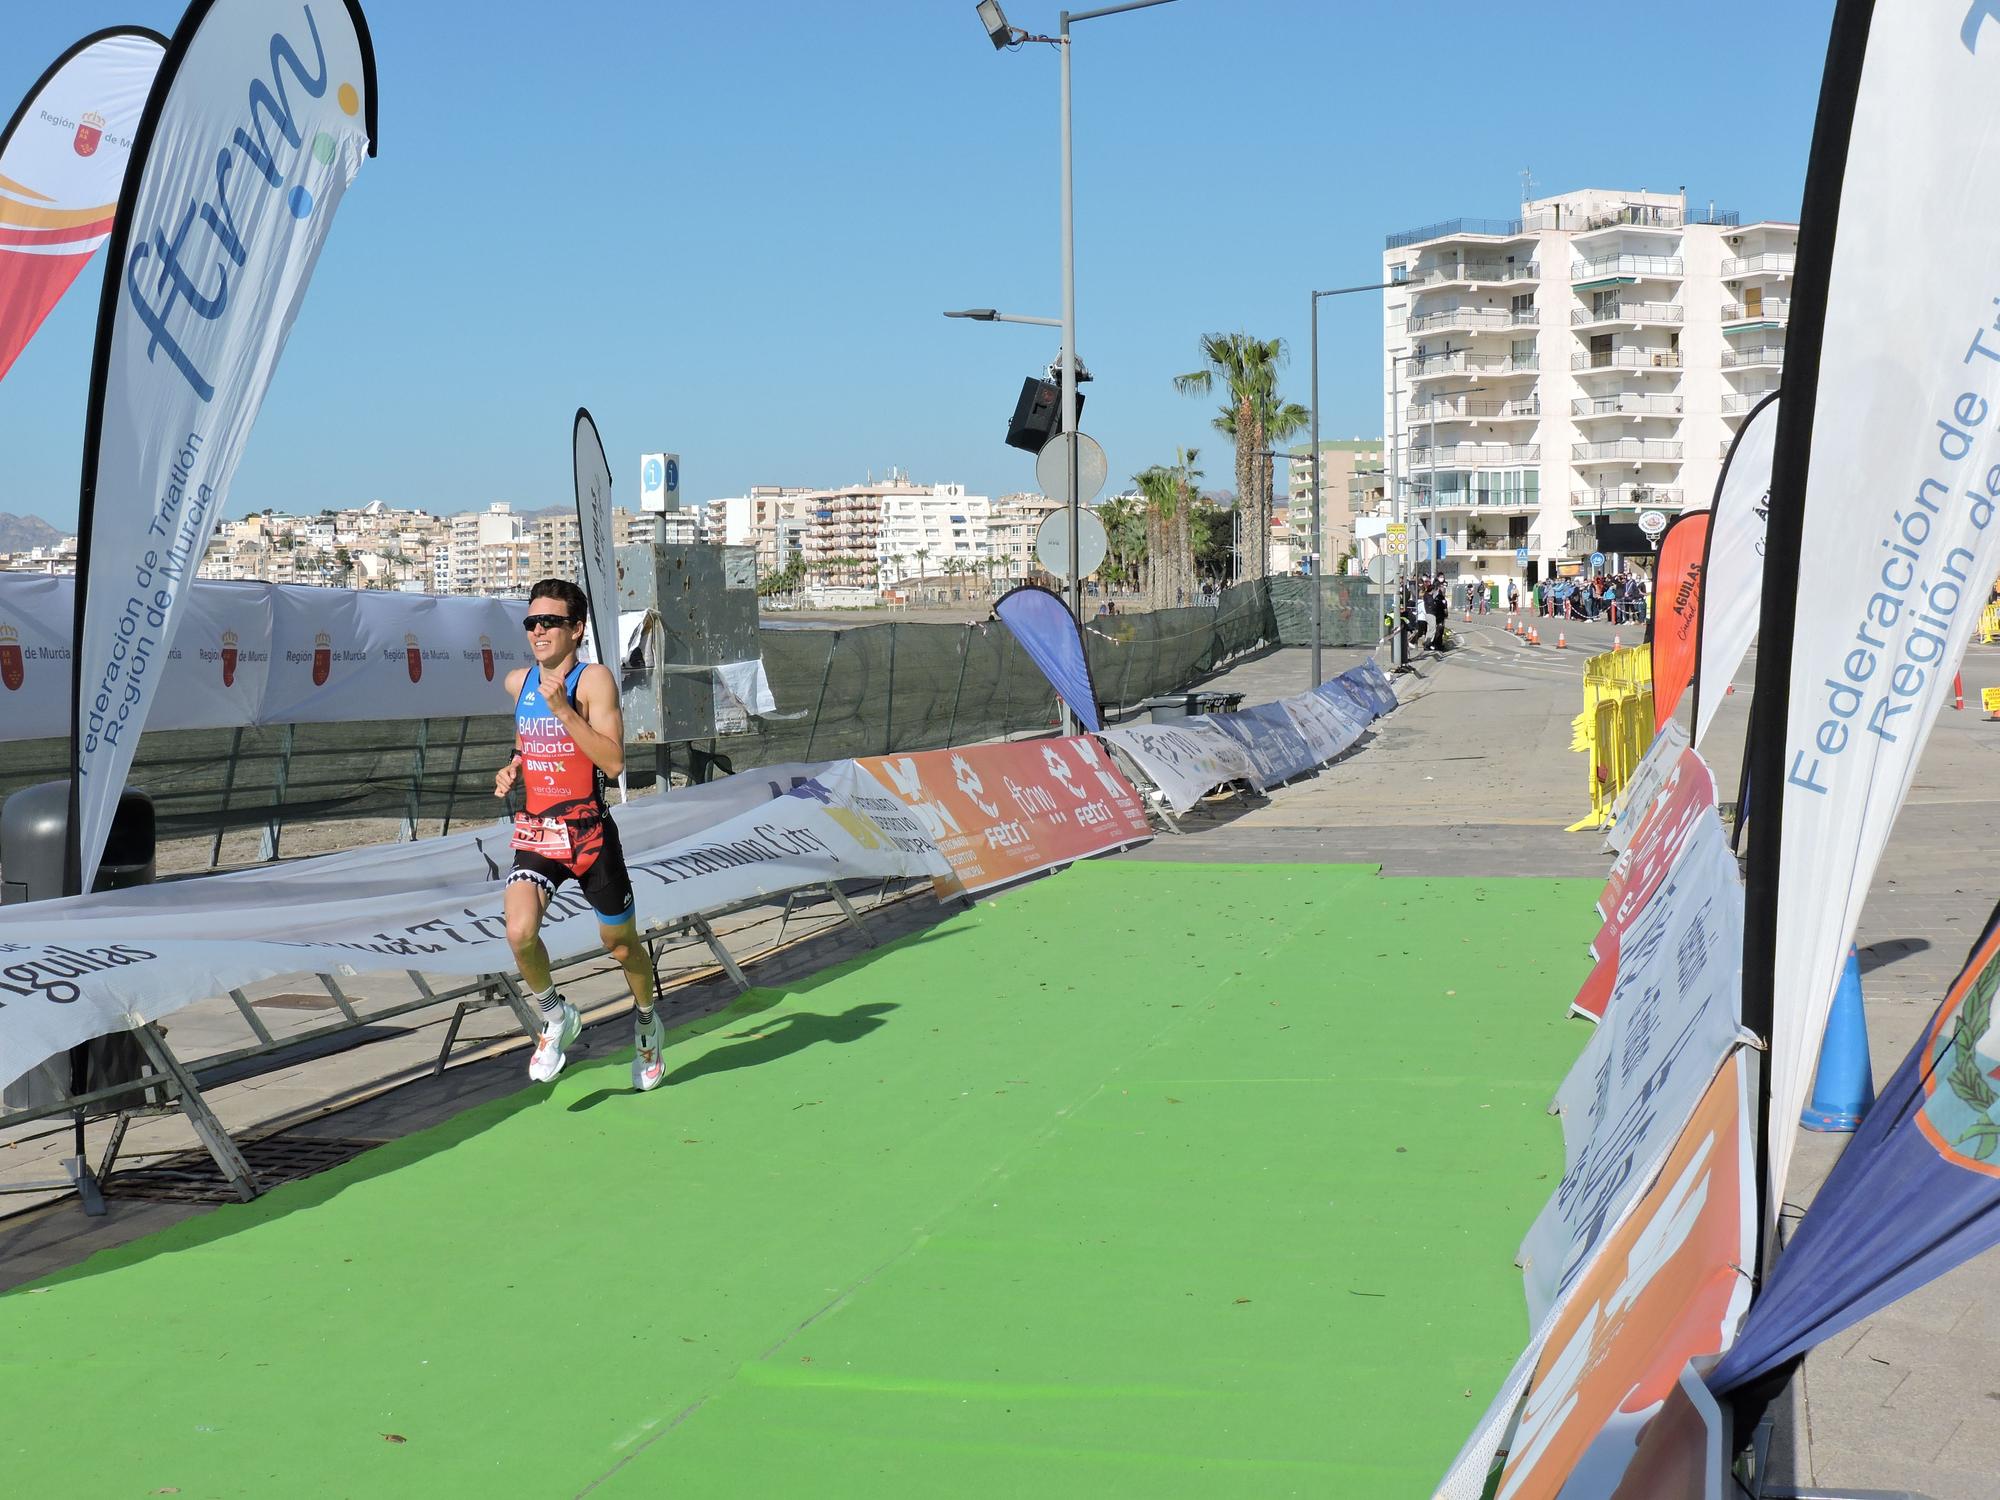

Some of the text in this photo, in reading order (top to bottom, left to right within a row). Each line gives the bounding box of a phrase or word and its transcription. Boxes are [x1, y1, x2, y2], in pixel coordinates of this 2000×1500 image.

[40, 110, 75, 130] Región
[104, 133, 118, 145] de
[136, 549, 158, 589] de
[149, 431, 204, 538] Triatlón
[1673, 562, 1702, 616] AGUILAS
[1788, 391, 1989, 796] Federación de
[103, 482, 213, 747] Región de Murcia
[24, 646, 71, 660] de Murcia
[168, 648, 183, 660] rcia
[286, 650, 367, 665] Región de Murcia
[384, 650, 405, 662] Región
[1866, 547, 1975, 745] Región
[519, 716, 567, 737] BAXTER
[527, 760, 567, 772] BNFIX
[0, 944, 158, 1008] guilas
